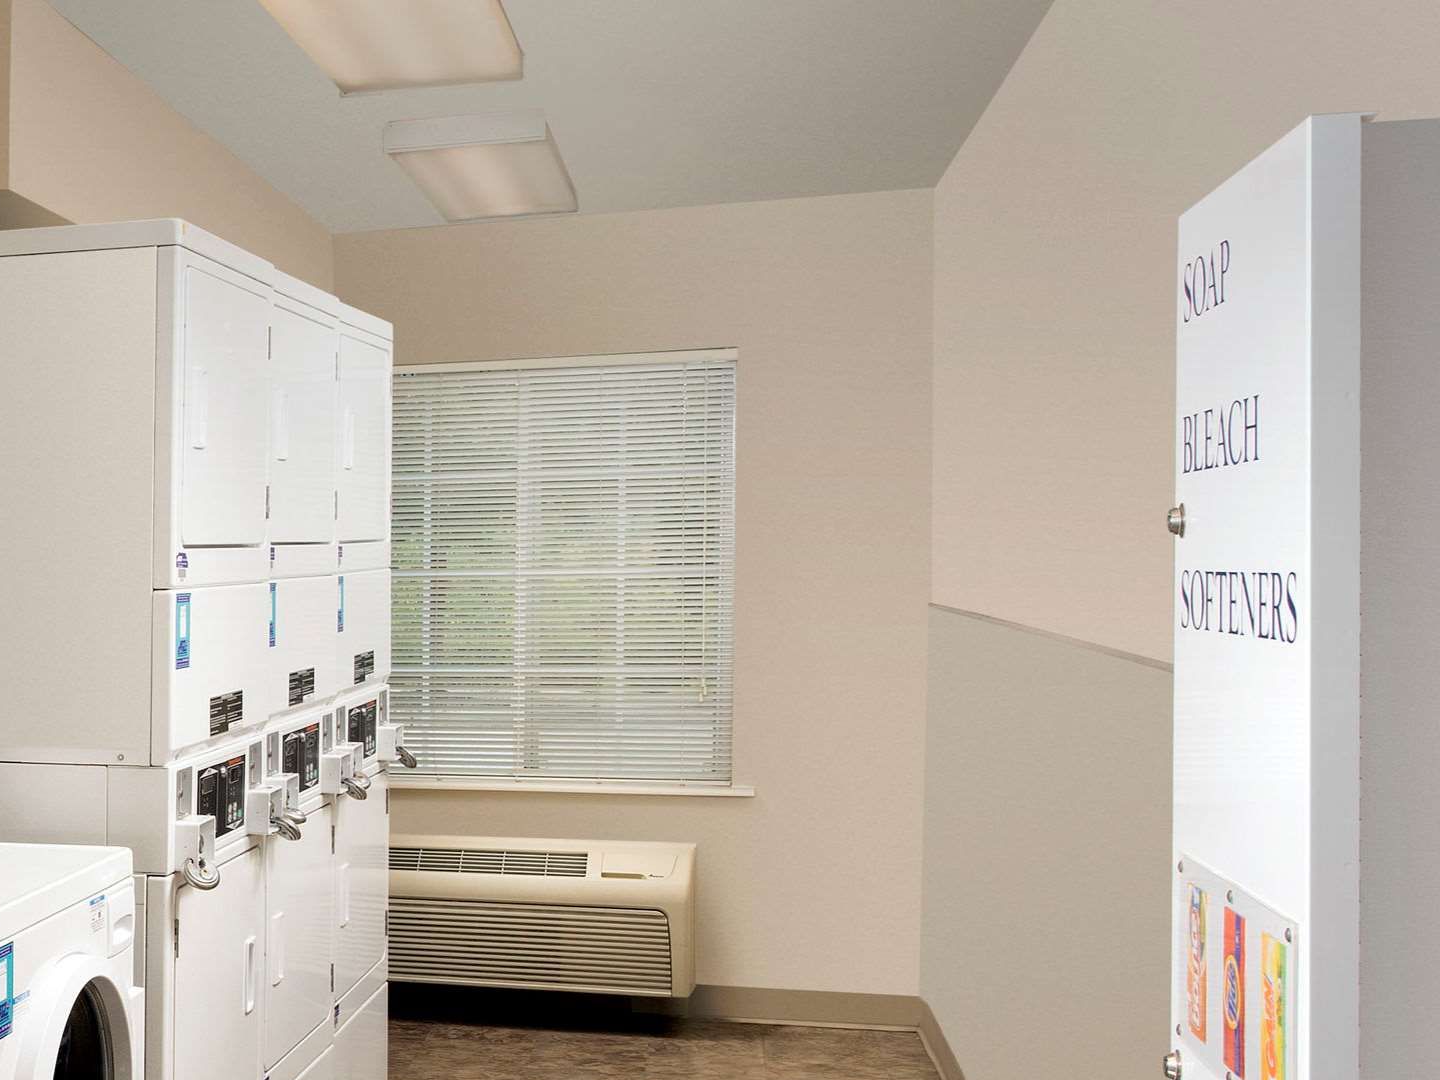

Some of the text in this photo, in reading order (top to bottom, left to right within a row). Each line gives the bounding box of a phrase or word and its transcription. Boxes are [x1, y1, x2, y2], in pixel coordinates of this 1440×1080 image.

[1183, 239, 1230, 324] SOAP
[1183, 394, 1260, 474] BLEACH
[1180, 569, 1298, 644] SOFTENERS
